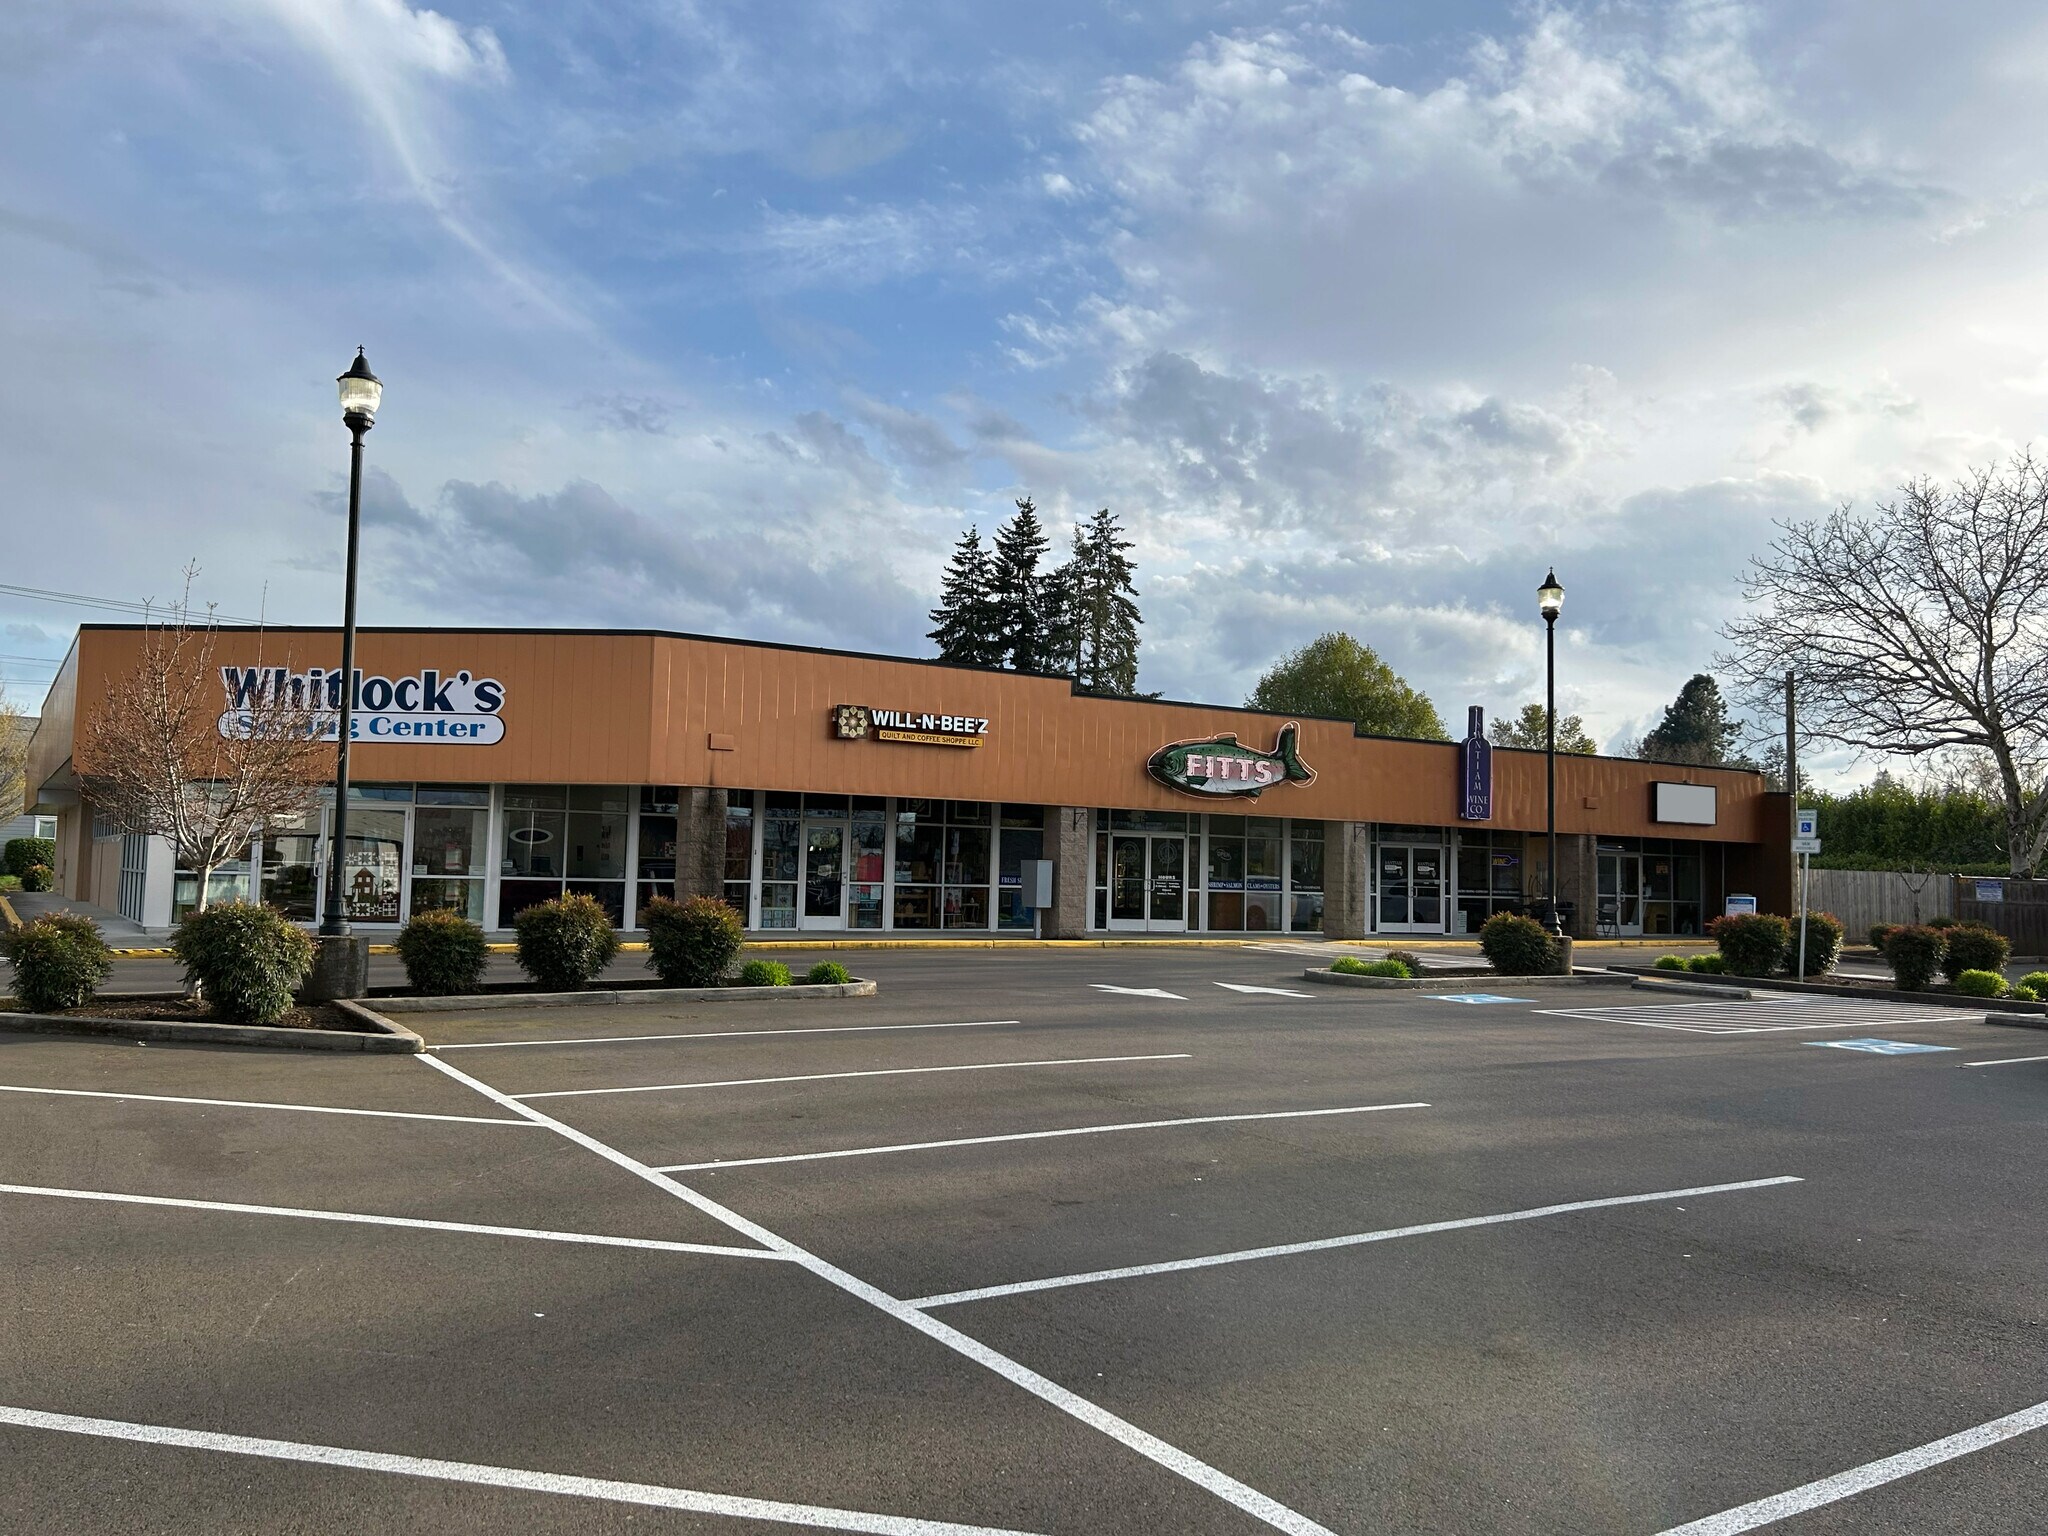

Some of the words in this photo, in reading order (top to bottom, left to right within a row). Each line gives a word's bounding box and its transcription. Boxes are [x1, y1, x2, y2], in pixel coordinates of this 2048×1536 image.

[369, 716, 485, 738] Center
[872, 710, 989, 734] WILL-N-BEE'Z
[1186, 754, 1272, 783] FITTS
